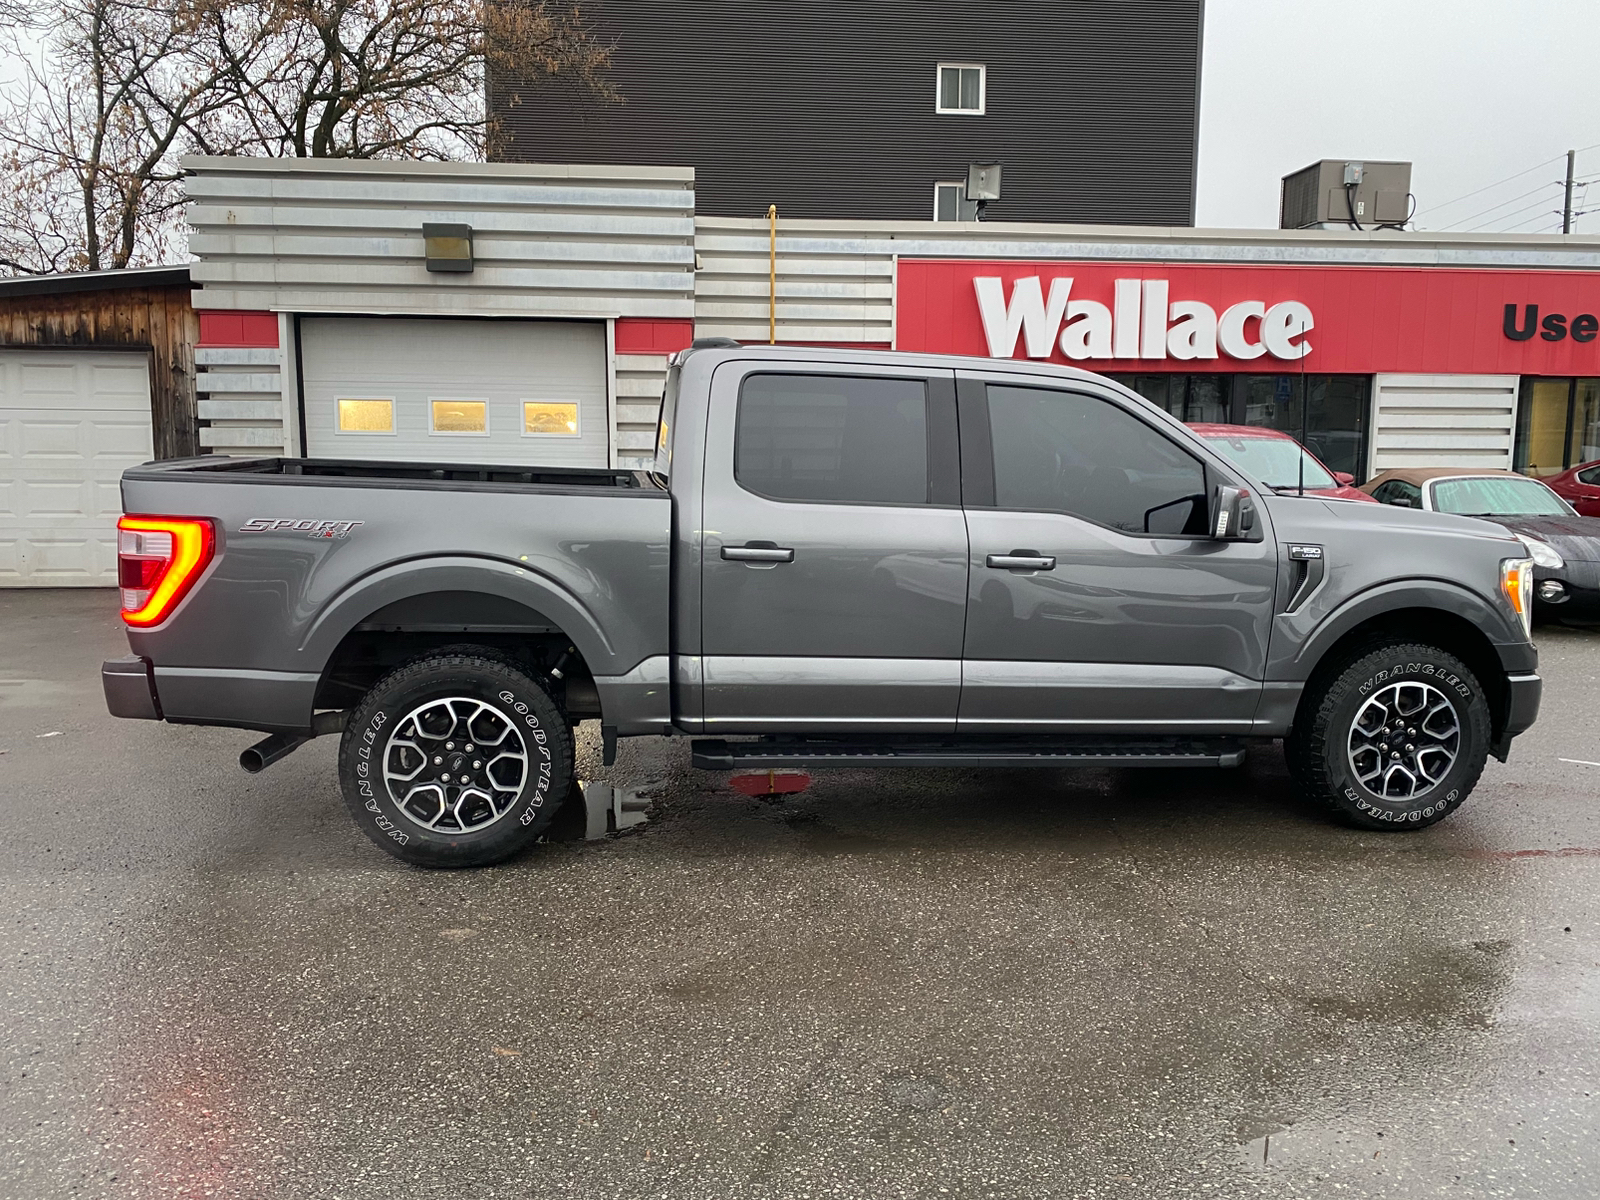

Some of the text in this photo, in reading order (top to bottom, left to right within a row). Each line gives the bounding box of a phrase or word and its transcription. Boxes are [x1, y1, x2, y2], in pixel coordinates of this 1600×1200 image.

[973, 275, 1314, 361] Wallace
[1503, 304, 1599, 342] Use
[239, 518, 364, 532] SPORT
[1359, 663, 1470, 698] WRANGLER
[499, 690, 552, 826] GOODYEAR
[357, 711, 409, 846] WRANGLER
[1345, 787, 1459, 822] GOODYEAR
